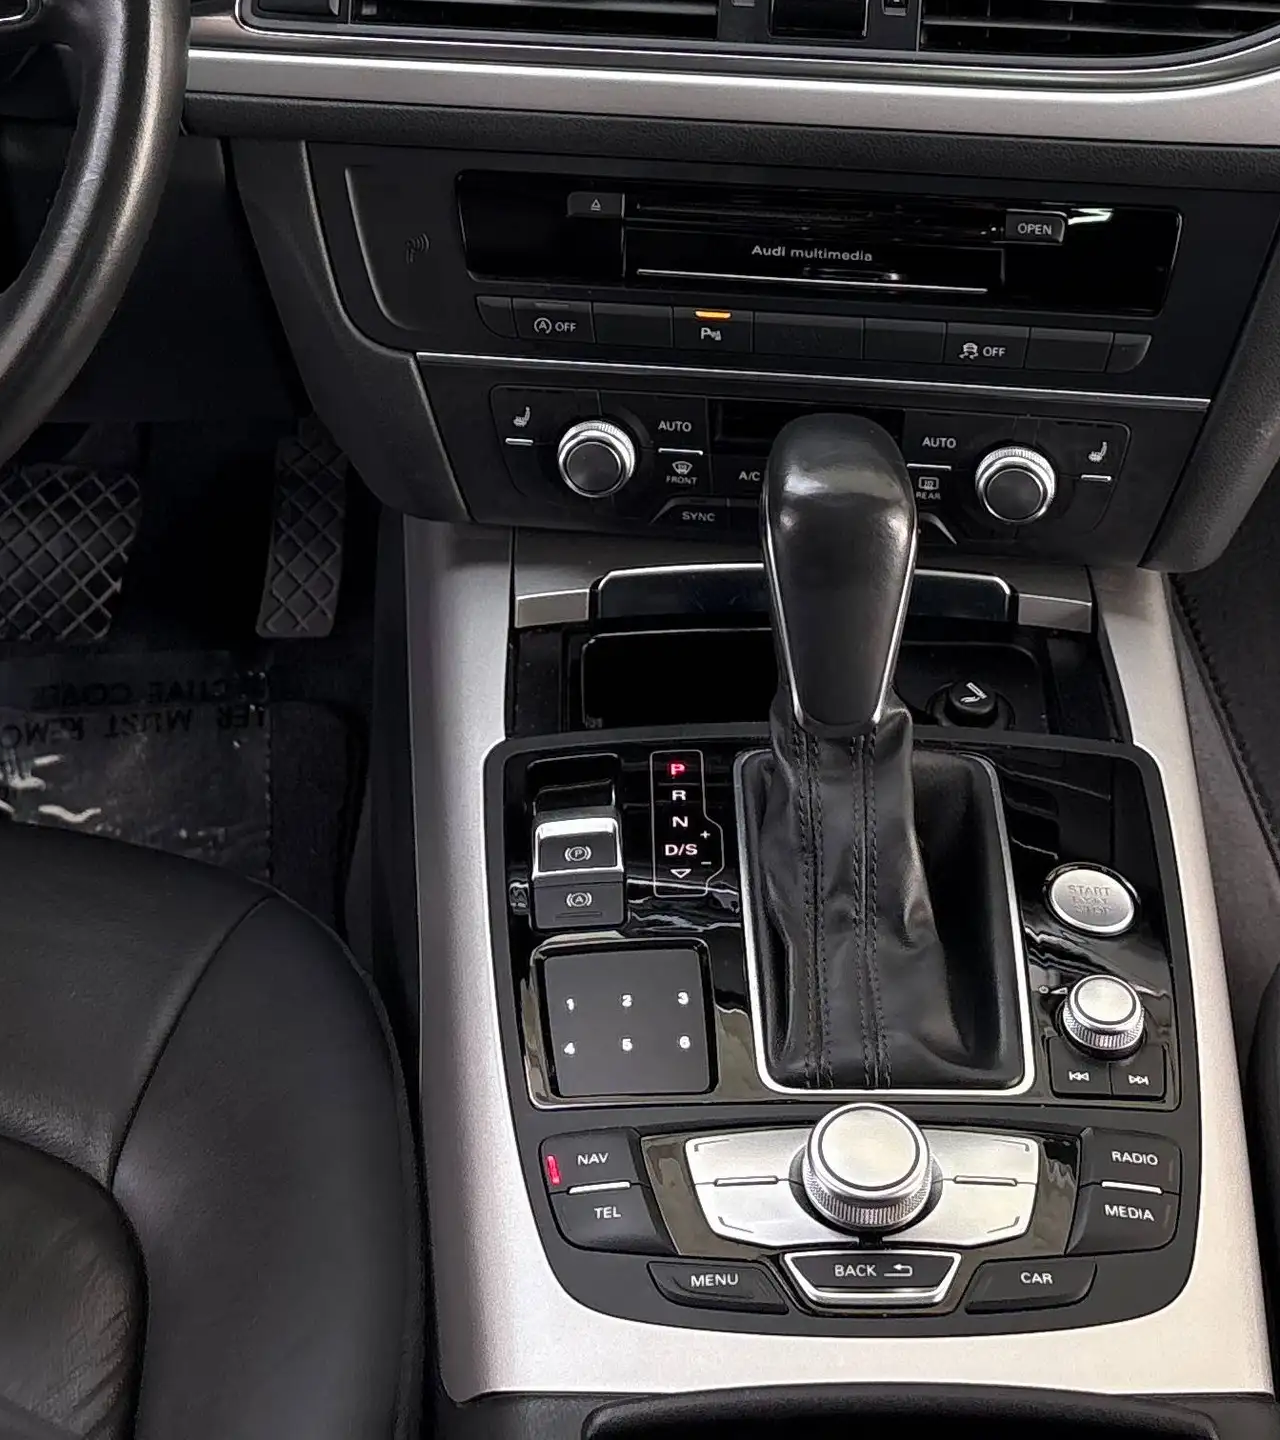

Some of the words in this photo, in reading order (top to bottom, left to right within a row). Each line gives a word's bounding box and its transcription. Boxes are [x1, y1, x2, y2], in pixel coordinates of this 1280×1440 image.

[1017, 222, 1052, 235] OPEN
[751, 244, 786, 257] Audi
[790, 247, 873, 262] multimedia
[554, 321, 577, 333] OFF
[982, 346, 1006, 357] OFF
[657, 420, 692, 433] AUTO
[921, 437, 957, 449] AUTO
[665, 474, 698, 486] FRONT
[738, 470, 761, 481] A/C
[915, 490, 942, 501] REAR
[681, 510, 716, 523] SYNC
[670, 763, 686, 776] P
[672, 789, 687, 801] R
[672, 816, 689, 827] N
[664, 843, 698, 856] D/S
[1067, 884, 1111, 897] START
[566, 998, 575, 1011] 1
[621, 994, 633, 1008] 2
[677, 991, 690, 1005] 3
[563, 1042, 576, 1055] 4
[622, 1038, 633, 1051] 5
[679, 1035, 691, 1049] 6
[577, 1152, 609, 1166] NAV
[1111, 1150, 1159, 1167] RADIO
[593, 1206, 622, 1220] TEL
[1104, 1203, 1155, 1222] MEDIA
[833, 1263, 878, 1278] BACK
[690, 1273, 739, 1288] MENU
[1019, 1271, 1053, 1285] CAR
